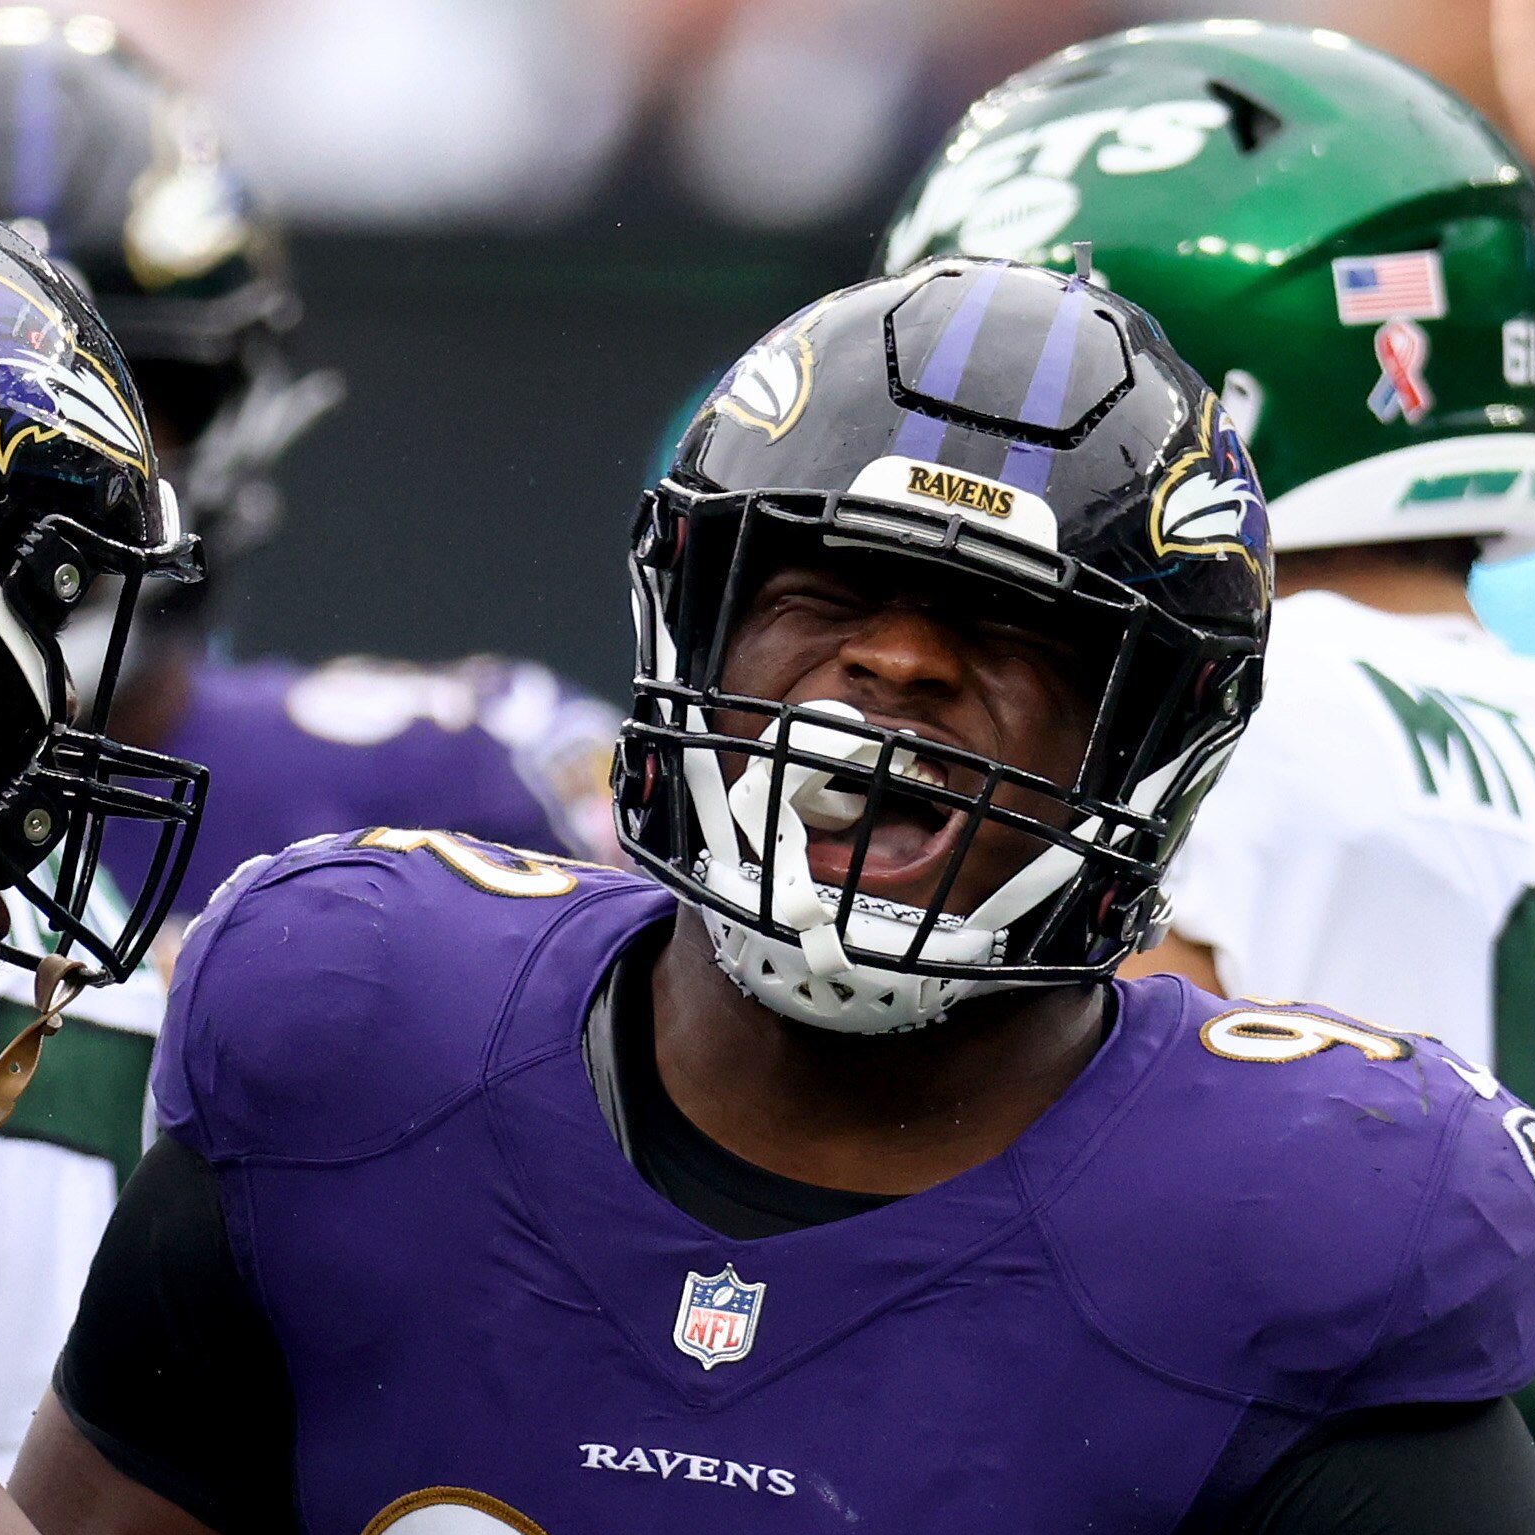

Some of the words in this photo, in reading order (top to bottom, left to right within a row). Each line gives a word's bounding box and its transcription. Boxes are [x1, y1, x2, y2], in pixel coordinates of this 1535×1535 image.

[885, 100, 1232, 278] JETS
[908, 466, 1015, 519] RAVENS
[685, 1305, 743, 1350] NFL
[578, 1443, 797, 1496] RAVENS
